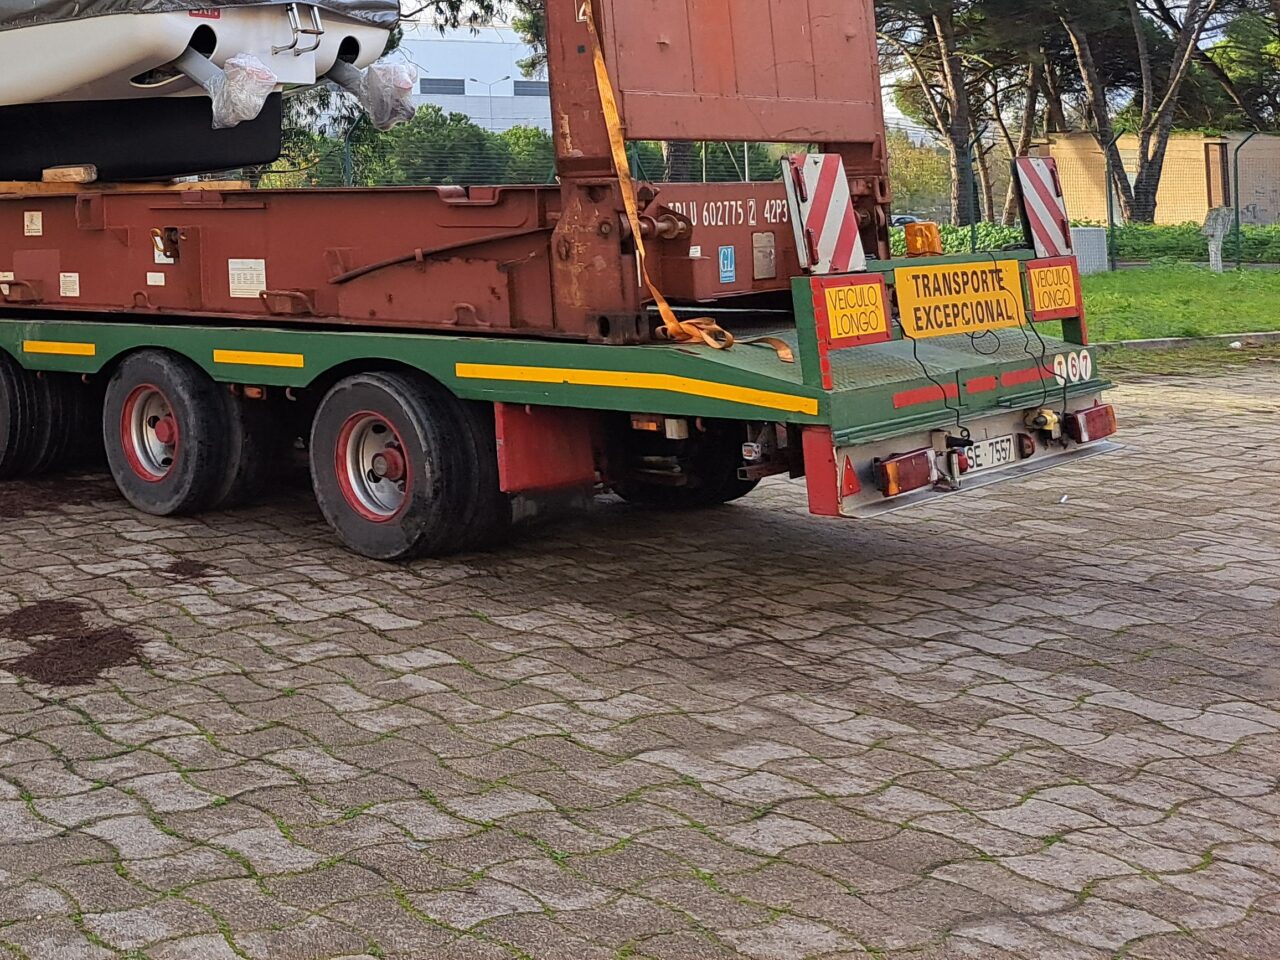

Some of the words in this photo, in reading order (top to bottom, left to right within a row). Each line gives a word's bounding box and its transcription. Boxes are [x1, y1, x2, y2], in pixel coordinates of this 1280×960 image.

[702, 200, 744, 227] 602775
[748, 200, 756, 224] 2
[764, 199, 788, 223] 42P3
[912, 269, 1004, 298] TRANSPORTE
[1033, 267, 1070, 288] VEICULO
[828, 286, 878, 310] VEICULO
[1038, 289, 1071, 310] LONGO
[835, 310, 879, 336] LONGO
[913, 298, 1014, 332] EXCEPCIONAL
